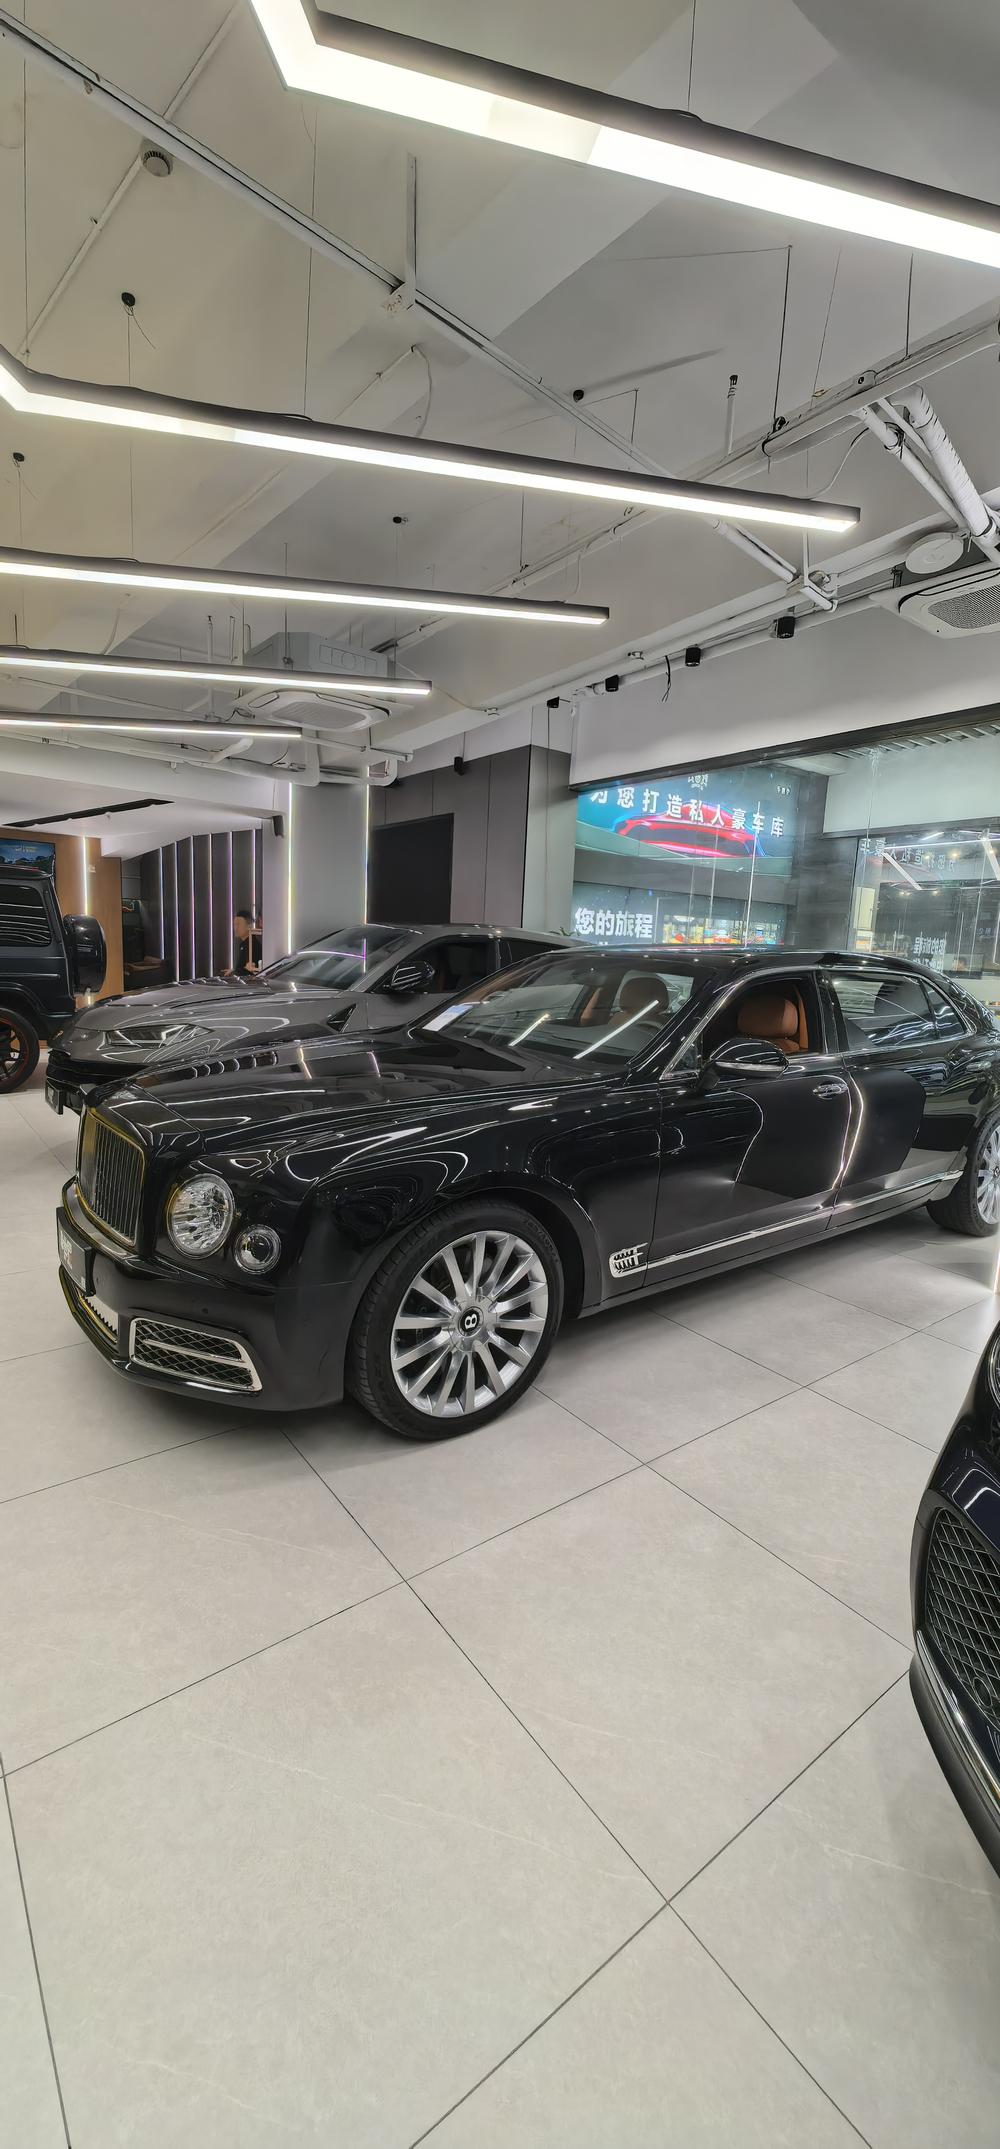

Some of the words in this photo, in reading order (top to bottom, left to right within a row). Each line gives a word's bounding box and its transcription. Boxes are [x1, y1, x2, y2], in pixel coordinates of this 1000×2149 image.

[591, 786, 785, 838] 为您打造私人豪车库
[574, 907, 653, 938] 您的旅程
